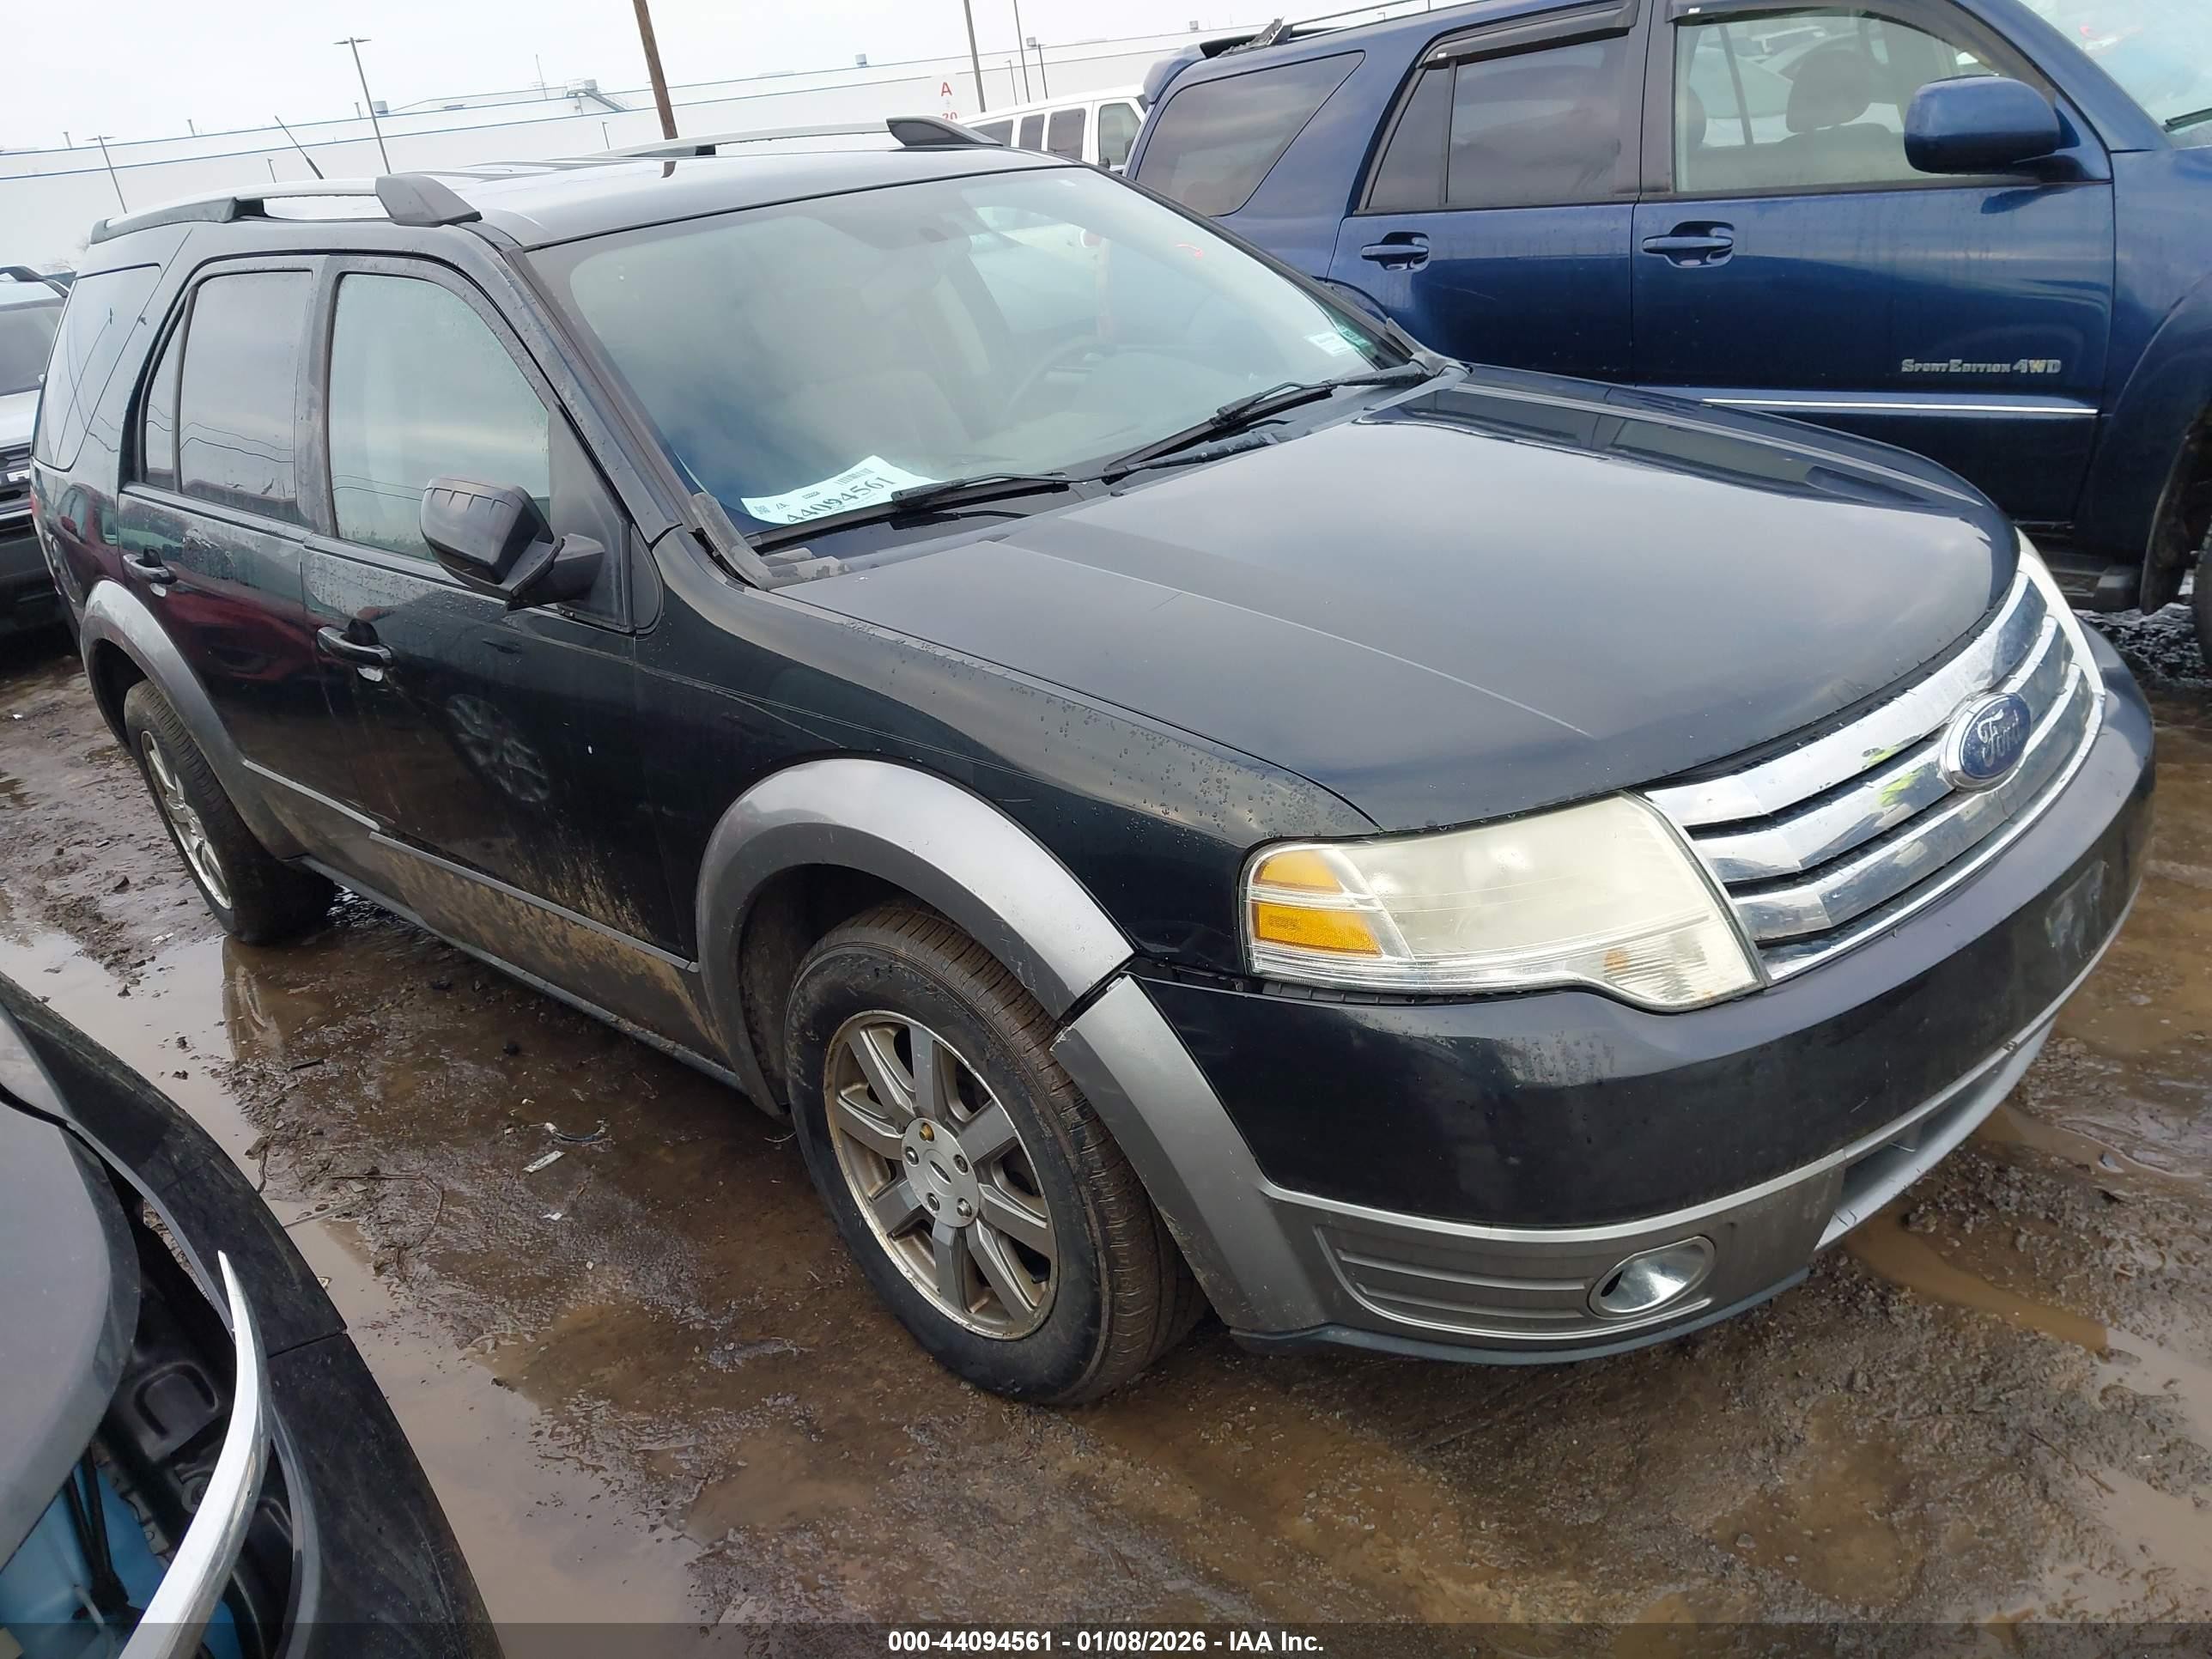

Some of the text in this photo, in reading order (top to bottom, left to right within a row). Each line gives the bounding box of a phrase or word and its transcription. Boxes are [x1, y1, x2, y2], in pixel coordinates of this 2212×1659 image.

[940, 81, 953, 97] A
[2012, 358, 2062, 374] 4WD
[787, 477, 896, 523] 44094561
[1976, 708, 2021, 768] Ford
